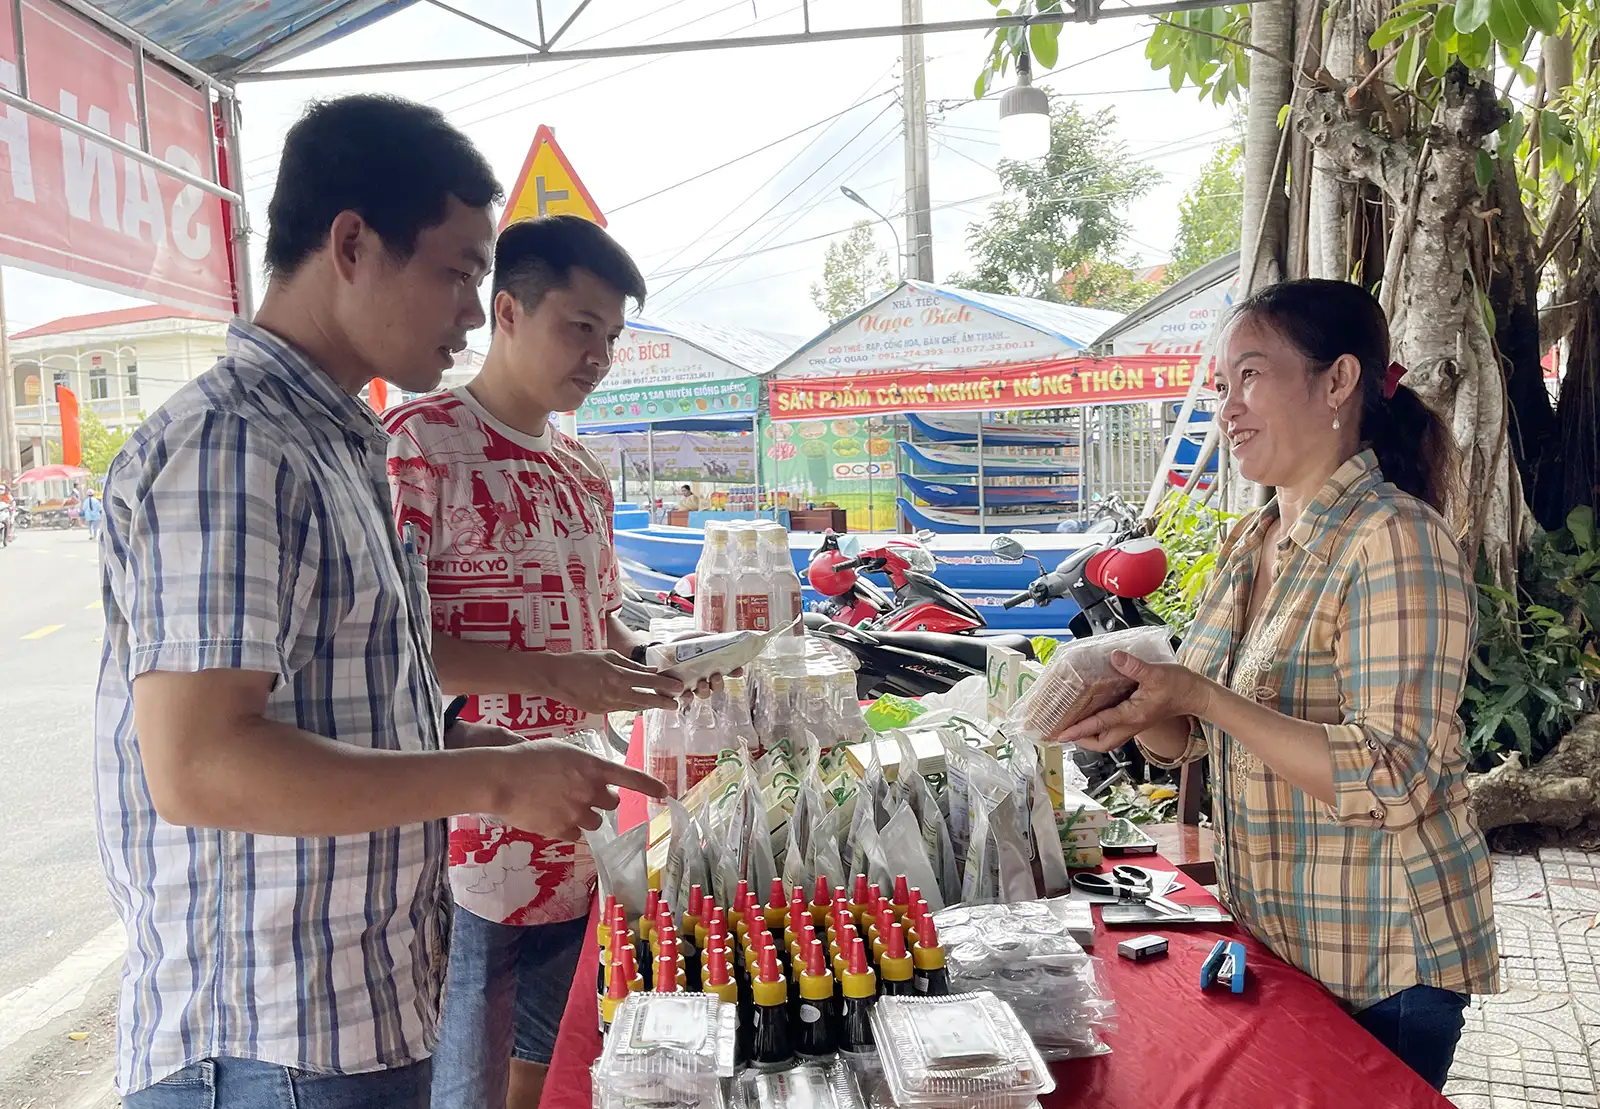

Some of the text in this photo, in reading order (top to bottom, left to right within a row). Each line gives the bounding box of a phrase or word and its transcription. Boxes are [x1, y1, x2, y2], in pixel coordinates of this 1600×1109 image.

[892, 296, 912, 310] NHÀ
[858, 305, 973, 333] Ngọc Bích
[1189, 309, 1208, 319] CHO
[611, 341, 670, 367] GỌC BÍCH
[844, 354, 868, 364] QUAO
[778, 386, 814, 411] SẢN
[819, 381, 871, 409] PHẨM
[877, 383, 928, 406] CÔNG
[932, 376, 1007, 404] NGHIỆP
[1013, 371, 1072, 397] NÔNG
[1078, 363, 1144, 394] THÔN
[620, 391, 640, 403] OCOP
[641, 391, 648, 400] 3
[648, 389, 664, 400] SAO
[836, 463, 893, 476] OCOP
